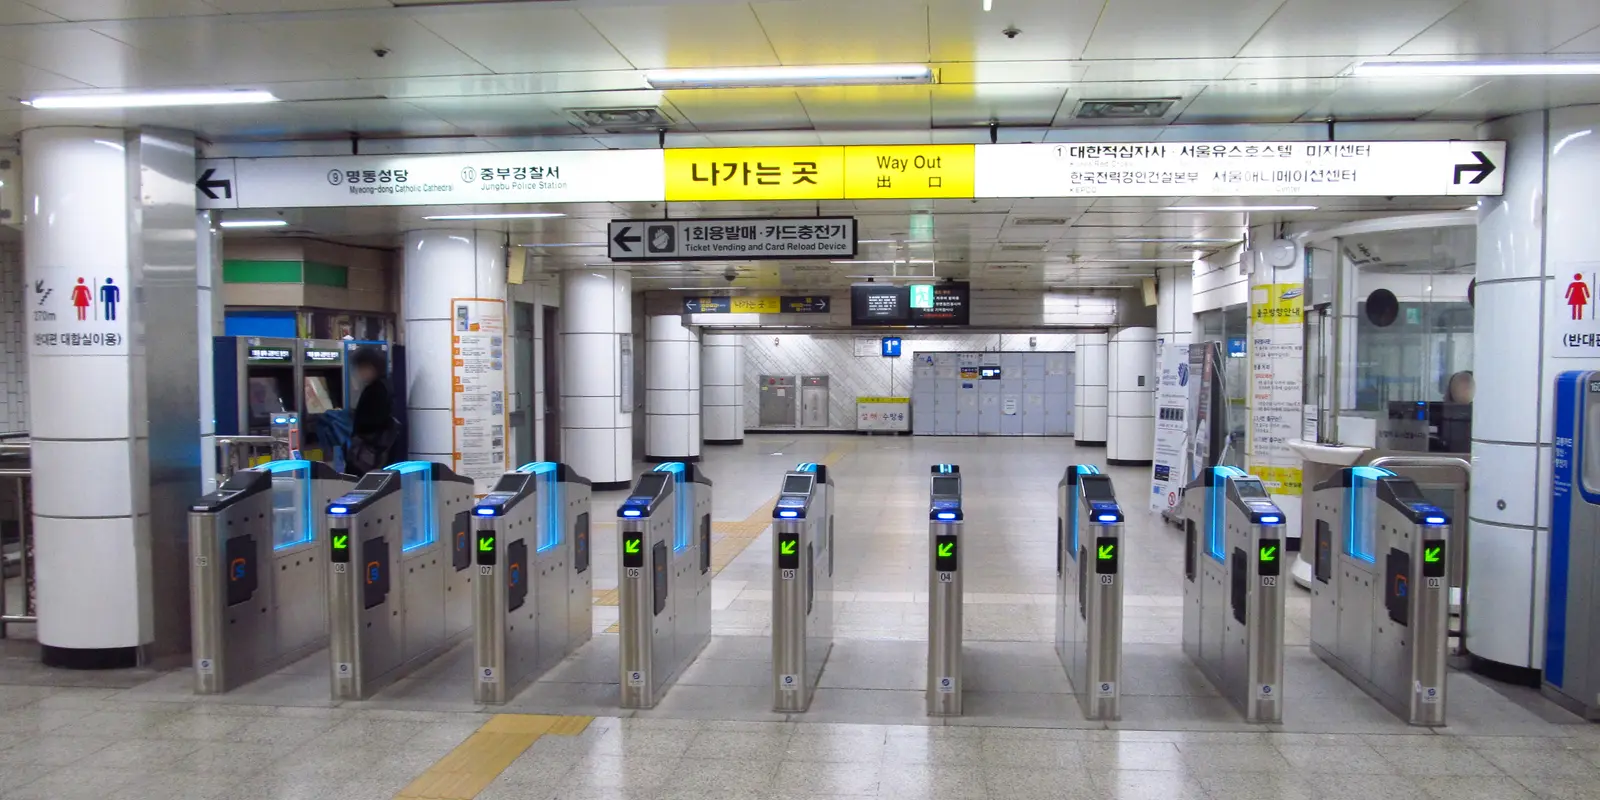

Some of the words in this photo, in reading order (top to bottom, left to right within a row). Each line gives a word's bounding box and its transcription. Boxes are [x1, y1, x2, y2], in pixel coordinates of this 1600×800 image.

[1070, 145, 1166, 159] 대한적십자사
[1180, 144, 1292, 158] 서울유스호스텔
[1306, 144, 1371, 157] 미지센터
[876, 155, 908, 172] Way
[913, 154, 942, 169] Out
[346, 169, 409, 183] 명동성당
[480, 166, 560, 180] 중부경찰서
[691, 161, 782, 186] 나가는
[791, 161, 818, 185] 곳
[481, 182, 510, 192] Jungbu
[512, 181, 537, 191] Police
[538, 180, 568, 190] Station
[685, 244, 711, 252] Ticket
[712, 244, 746, 253] Vending
[747, 243, 763, 251] and
[764, 242, 785, 251] Card
[786, 242, 816, 251] Reload
[818, 242, 847, 251] Device
[335, 563, 345, 572] 08
[481, 566, 491, 575] 07
[628, 568, 639, 577] 06
[783, 569, 794, 579] 05
[940, 572, 951, 582] 04
[1101, 575, 1112, 584] 03
[1263, 577, 1275, 586] 02
[1428, 578, 1439, 588] 01
